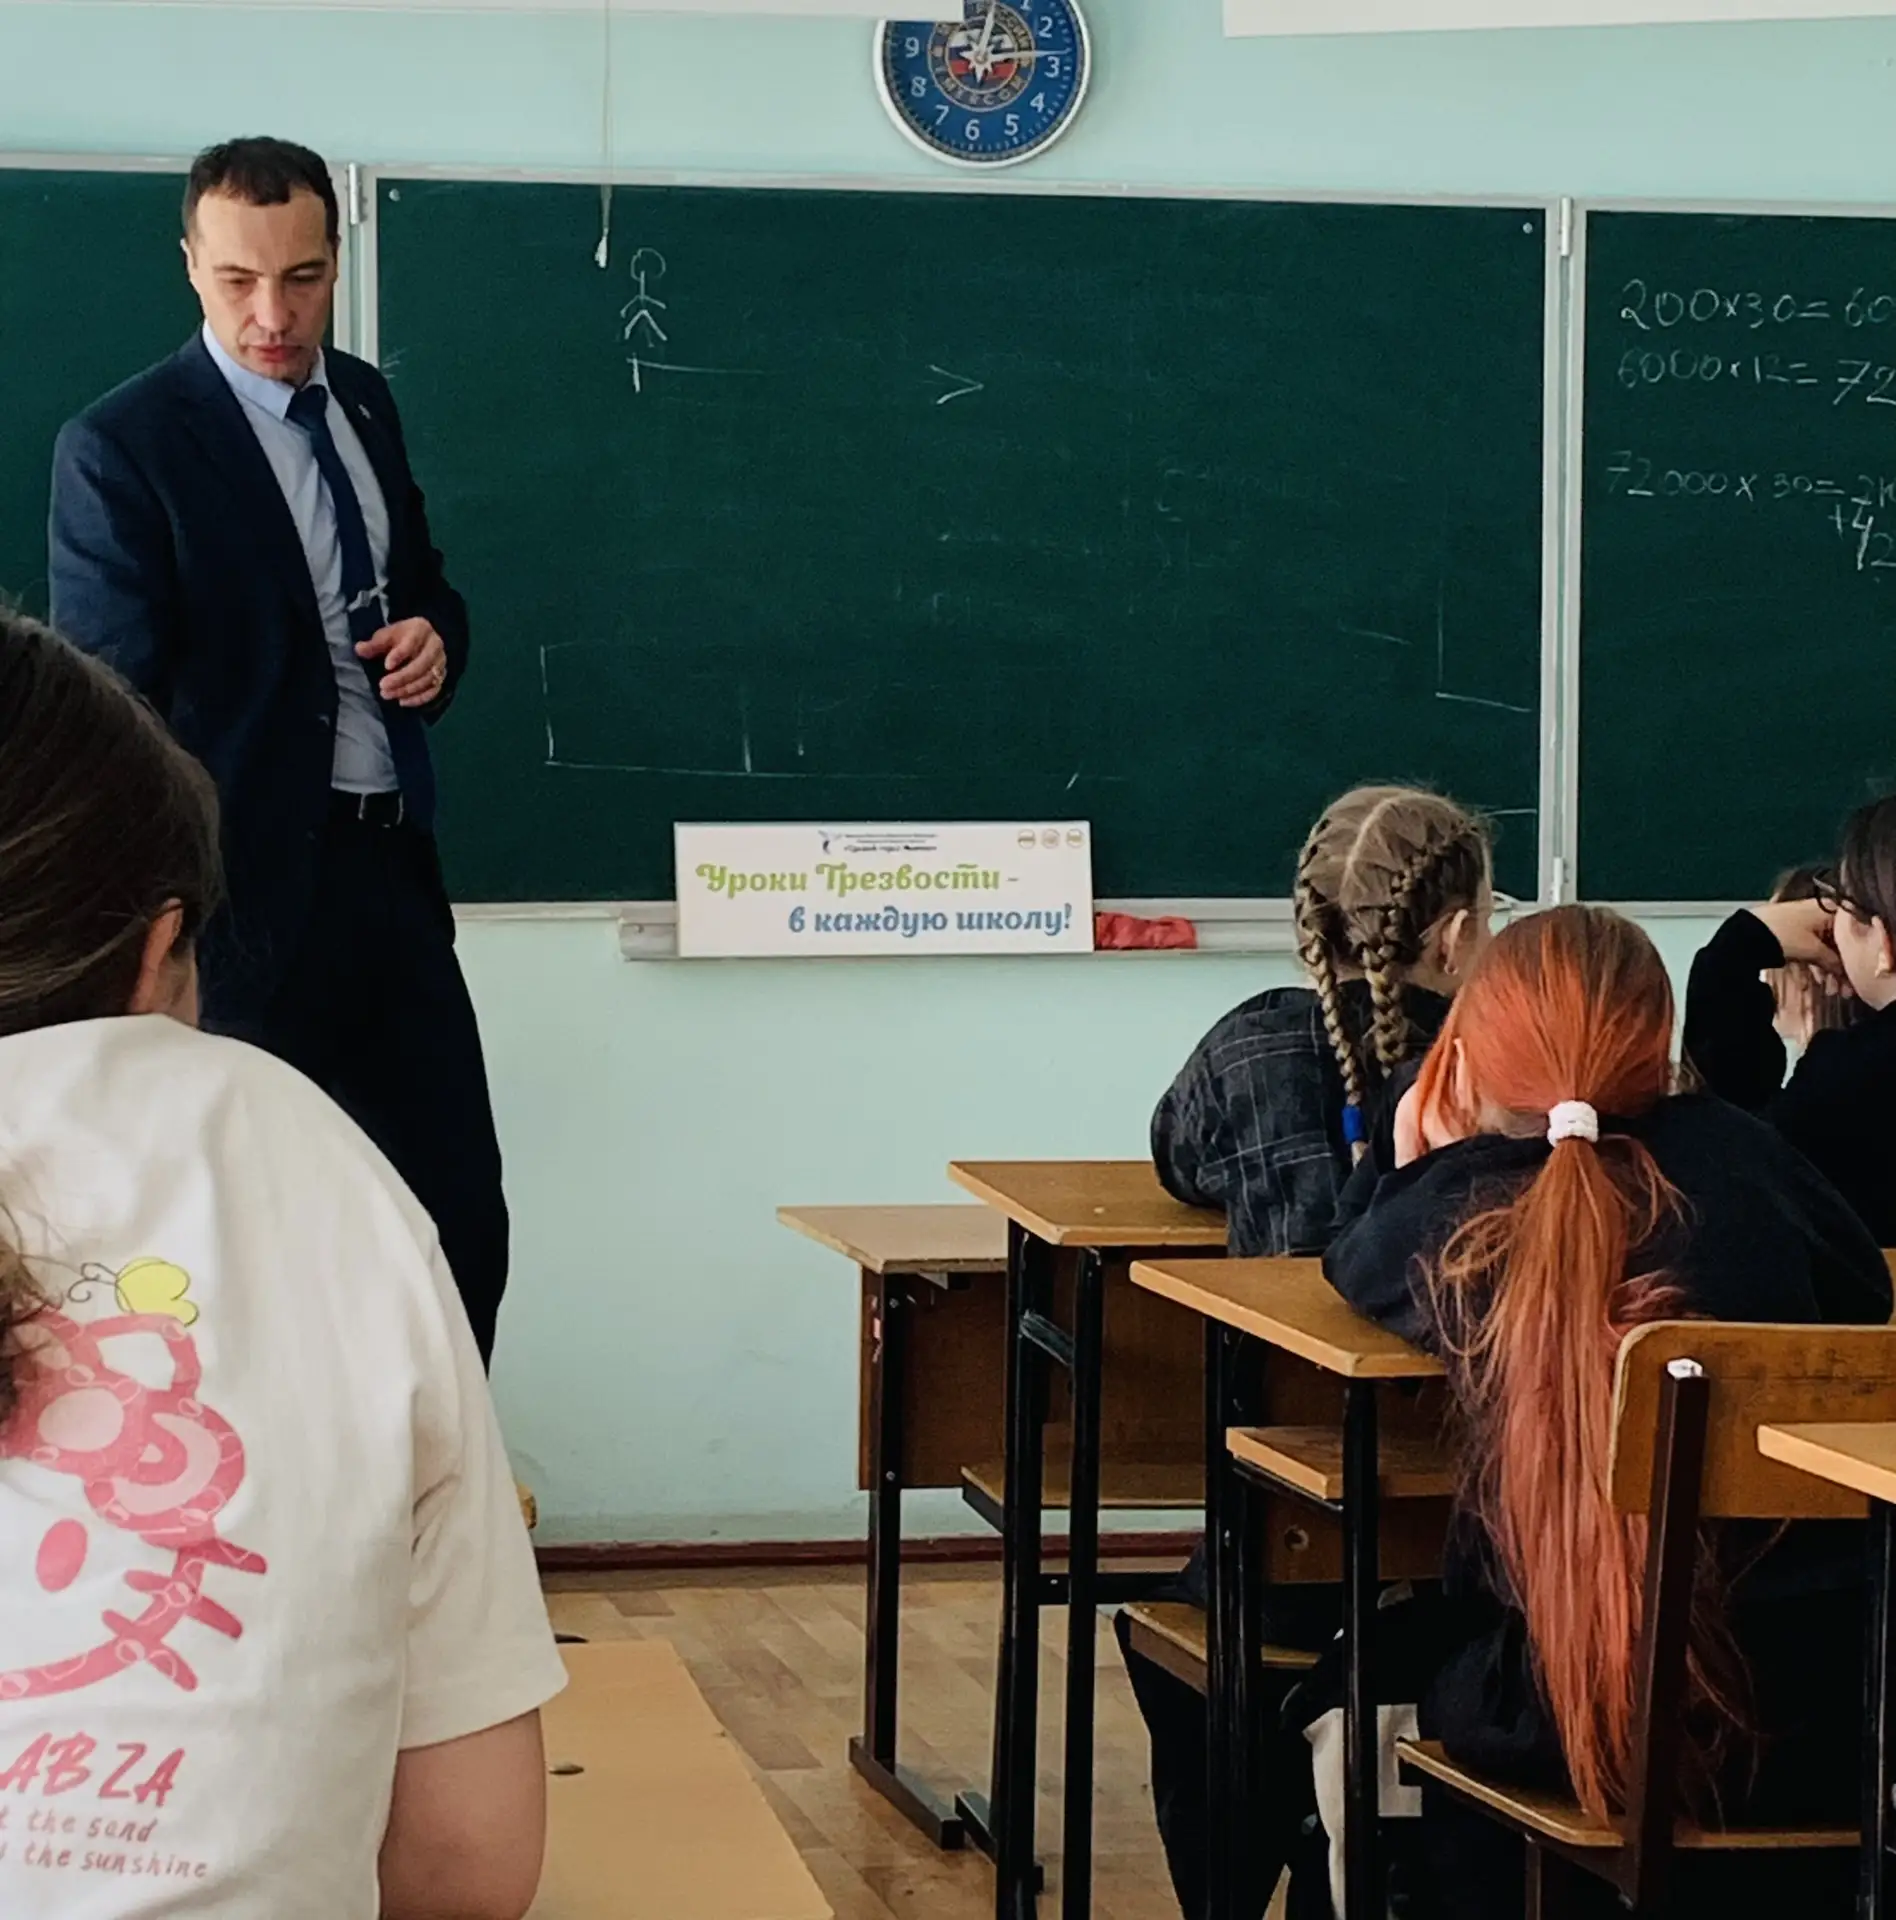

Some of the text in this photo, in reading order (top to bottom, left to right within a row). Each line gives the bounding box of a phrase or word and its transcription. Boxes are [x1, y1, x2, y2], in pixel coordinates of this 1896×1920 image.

[1038, 16, 1053, 38] 2
[904, 37, 920, 58] 9
[1044, 56, 1060, 78] 3
[910, 76, 927, 98] 8
[1030, 92, 1045, 113] 4
[935, 104, 949, 126] 7
[1004, 114, 1020, 136] 5
[965, 119, 980, 141] 6
[695, 863, 808, 899] Уроки
[815, 862, 1000, 898] Трезвости
[788, 902, 1073, 938] в каждую школу!
[27, 1807, 77, 1835] the
[87, 1816, 159, 1843] sand
[24, 1842, 72, 1868] the
[80, 1851, 208, 1879] sunshine
